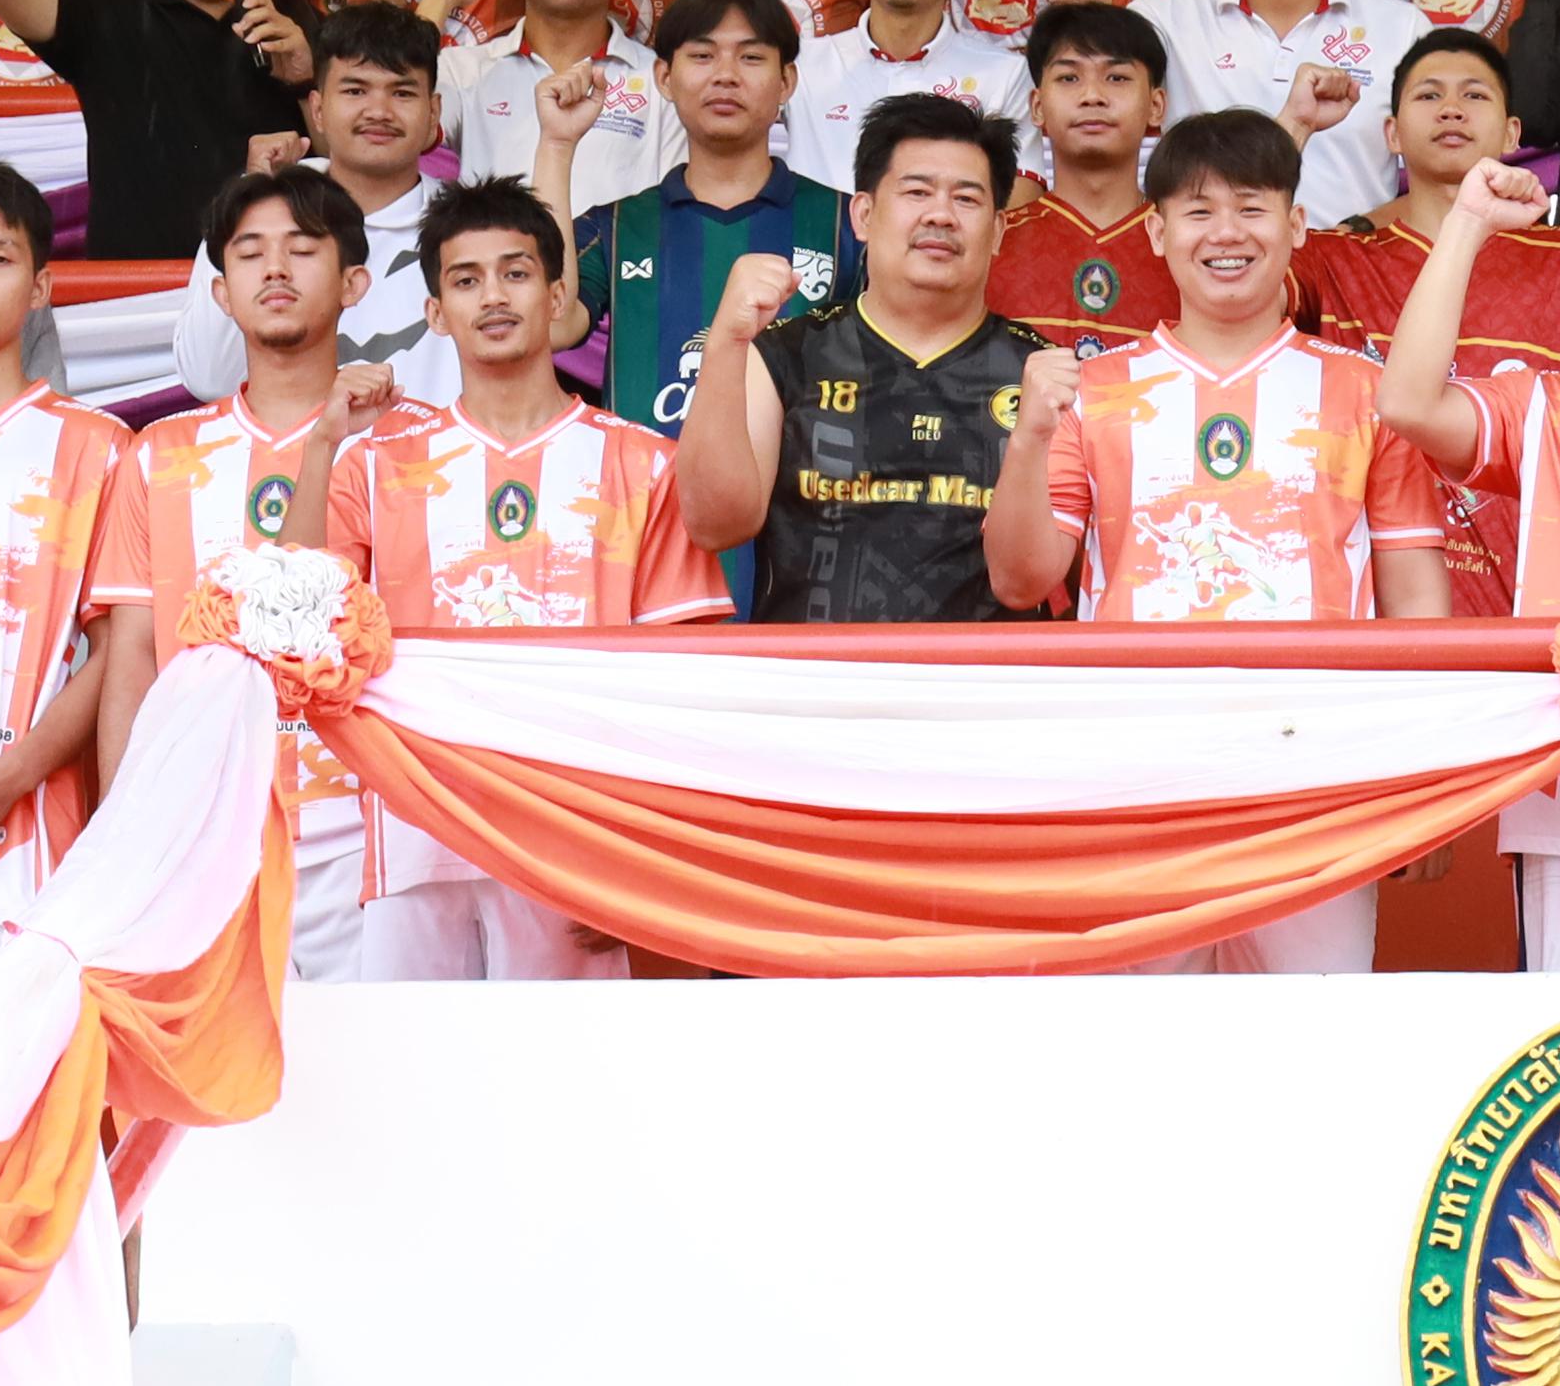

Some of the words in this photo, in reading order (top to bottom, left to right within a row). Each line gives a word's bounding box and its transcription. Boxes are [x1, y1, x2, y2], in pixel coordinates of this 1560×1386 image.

[817, 379, 859, 413] 18
[912, 429, 942, 441] IDEO
[797, 469, 922, 504] Usedcar
